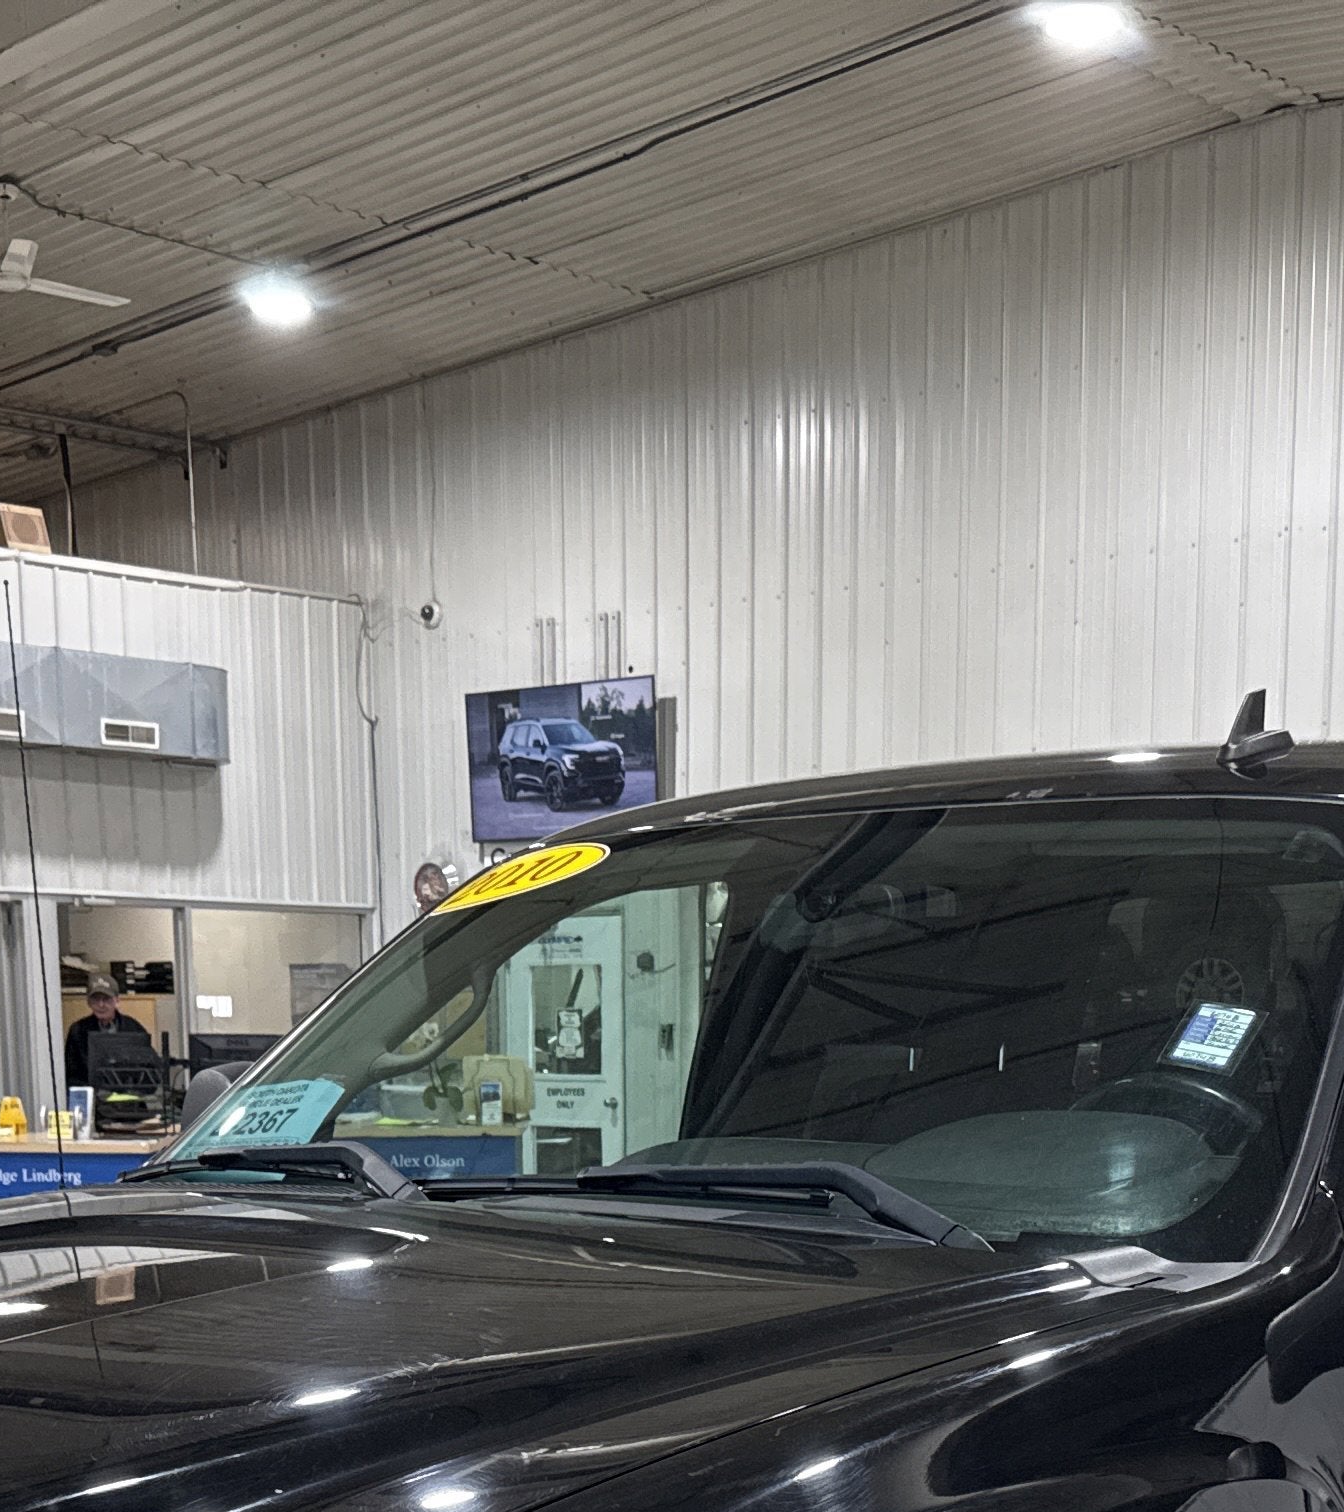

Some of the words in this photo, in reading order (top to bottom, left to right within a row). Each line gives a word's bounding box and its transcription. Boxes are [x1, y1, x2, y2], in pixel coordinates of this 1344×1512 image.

[546, 1087, 585, 1097] EMPLOYEES
[556, 1099, 575, 1110] ONLY
[391, 1153, 420, 1168] Alex
[424, 1153, 465, 1168] Olson
[21, 1167, 82, 1186] Lindberg
